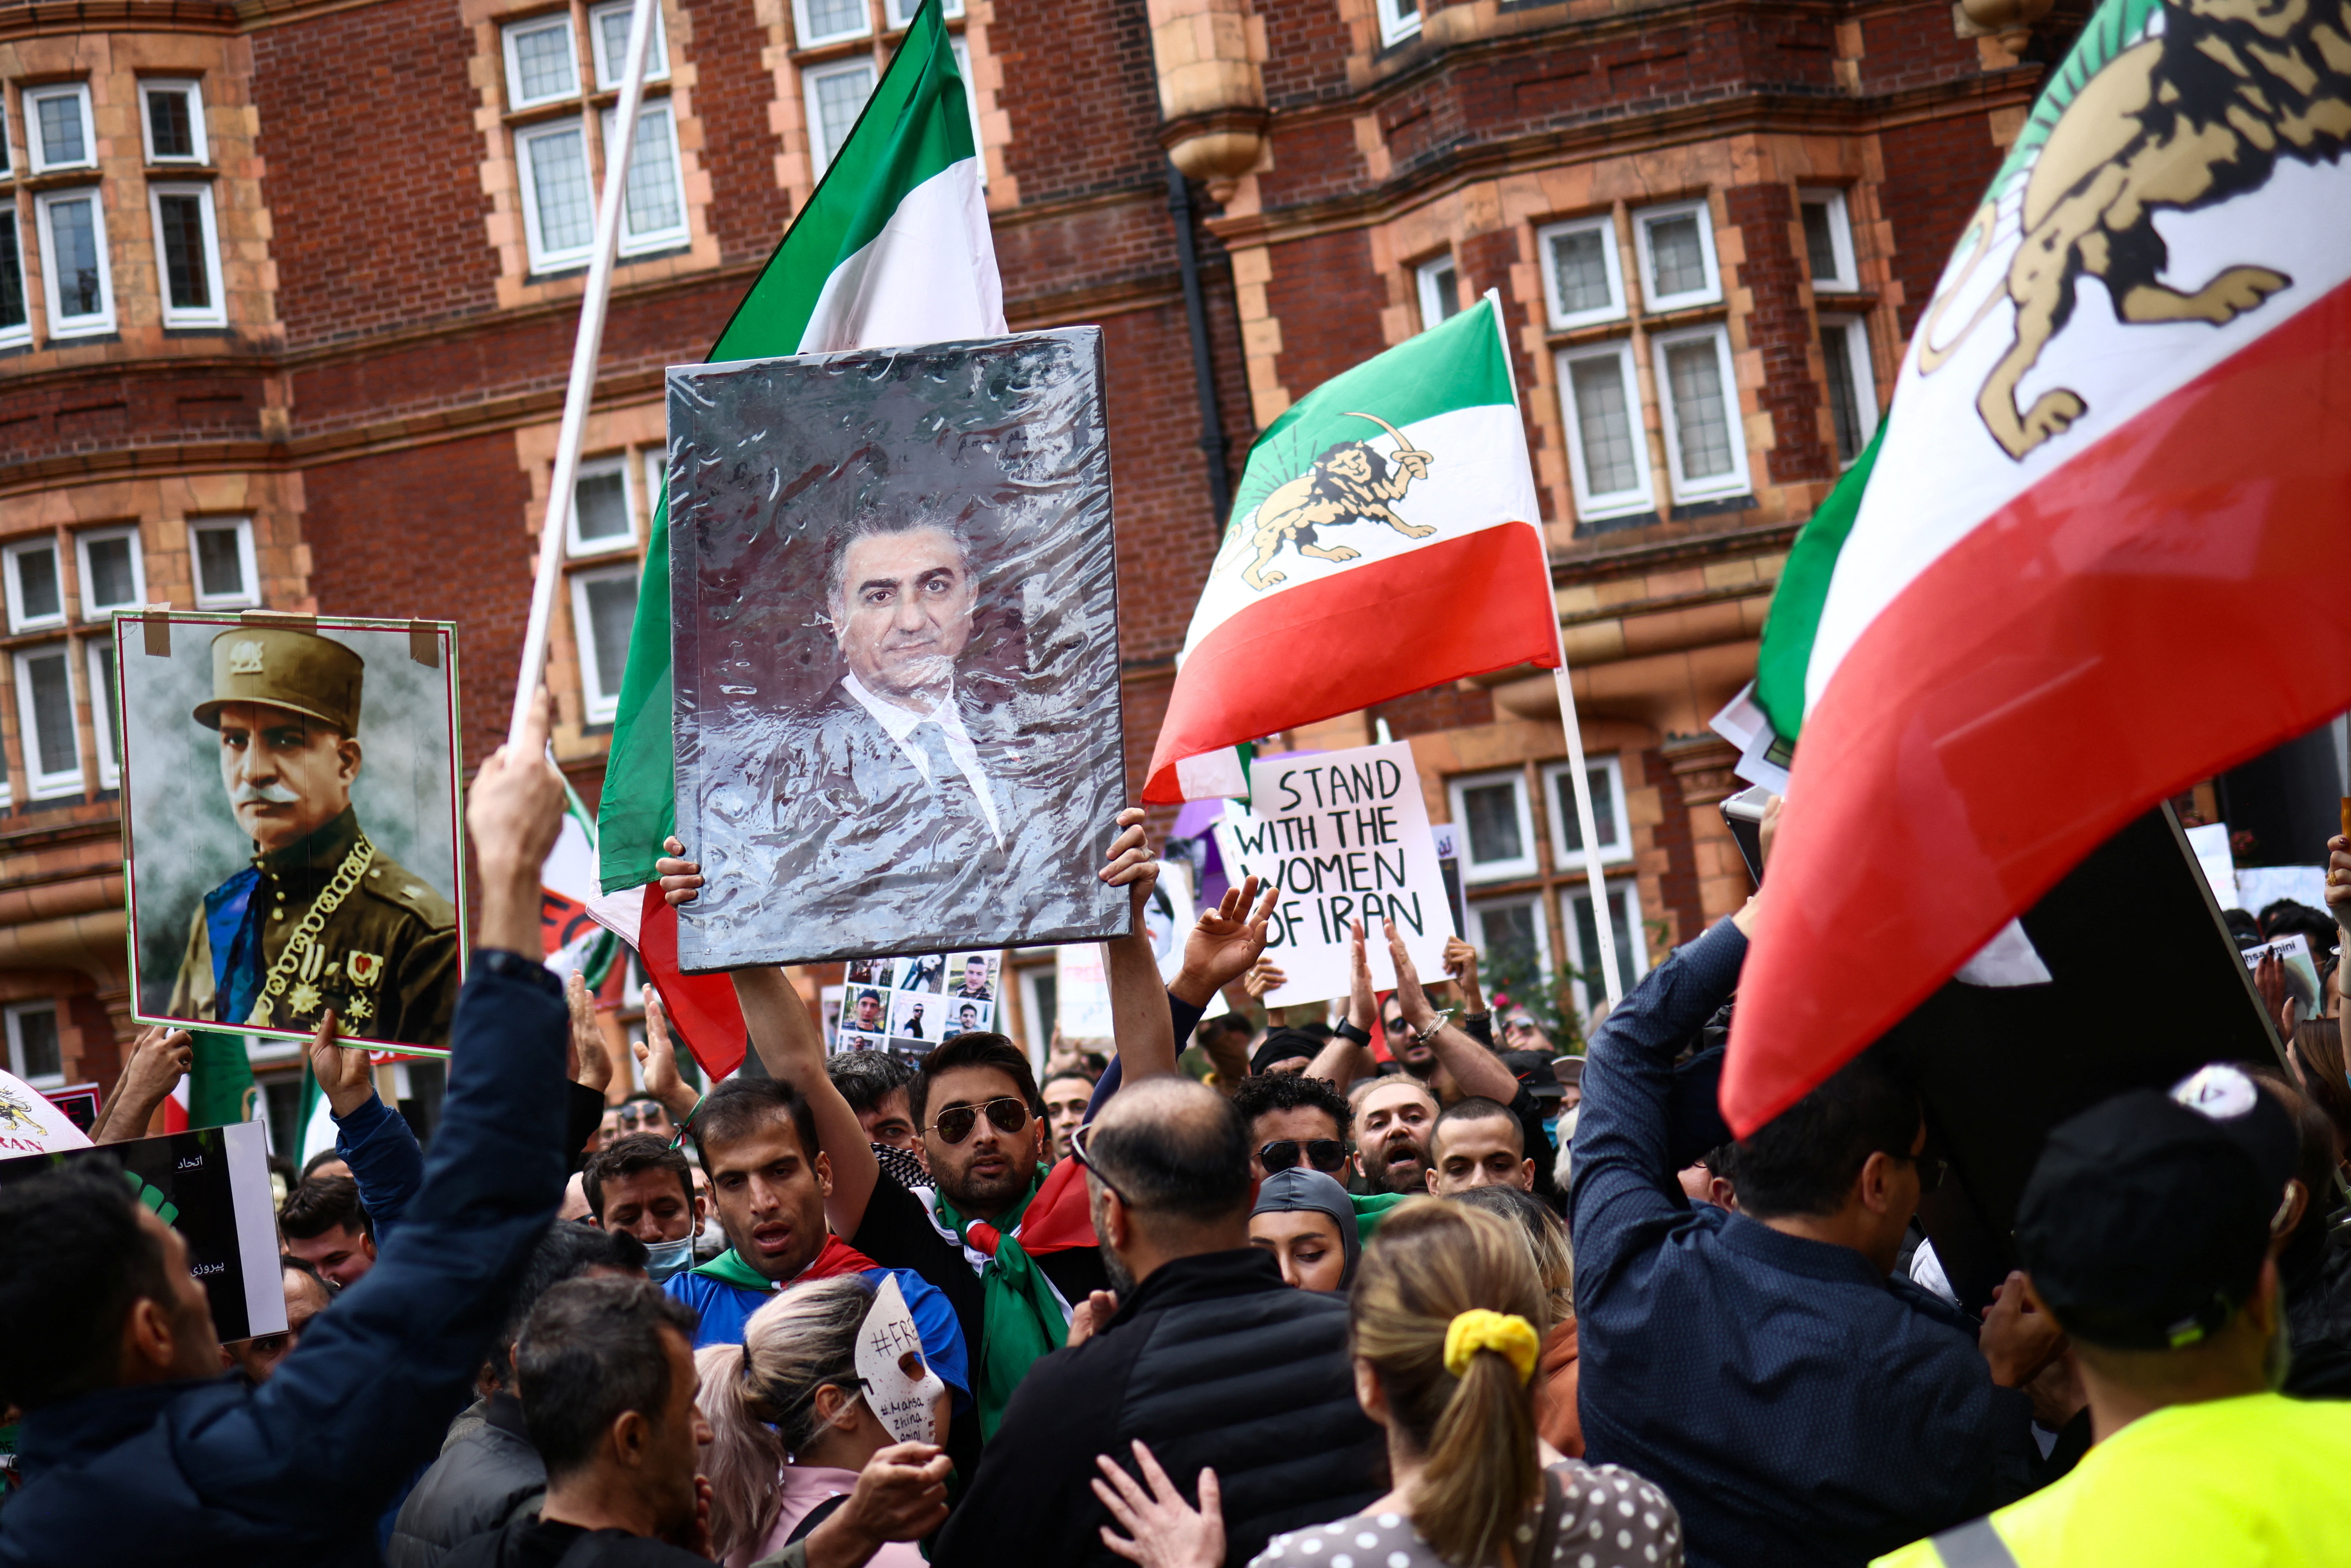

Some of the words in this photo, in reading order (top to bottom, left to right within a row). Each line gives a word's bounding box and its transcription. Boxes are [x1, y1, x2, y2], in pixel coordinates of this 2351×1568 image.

[1279, 759, 1401, 812] STAND
[1234, 815, 1318, 856] WITH
[1327, 806, 1398, 849] THE
[1240, 848, 1405, 898] WOMEN
[1317, 892, 1424, 944] IRAN
[178, 1155, 203, 1169] اتحاد
[190, 1262, 225, 1277] پیروزی
[870, 1317, 919, 1358] #FRE
